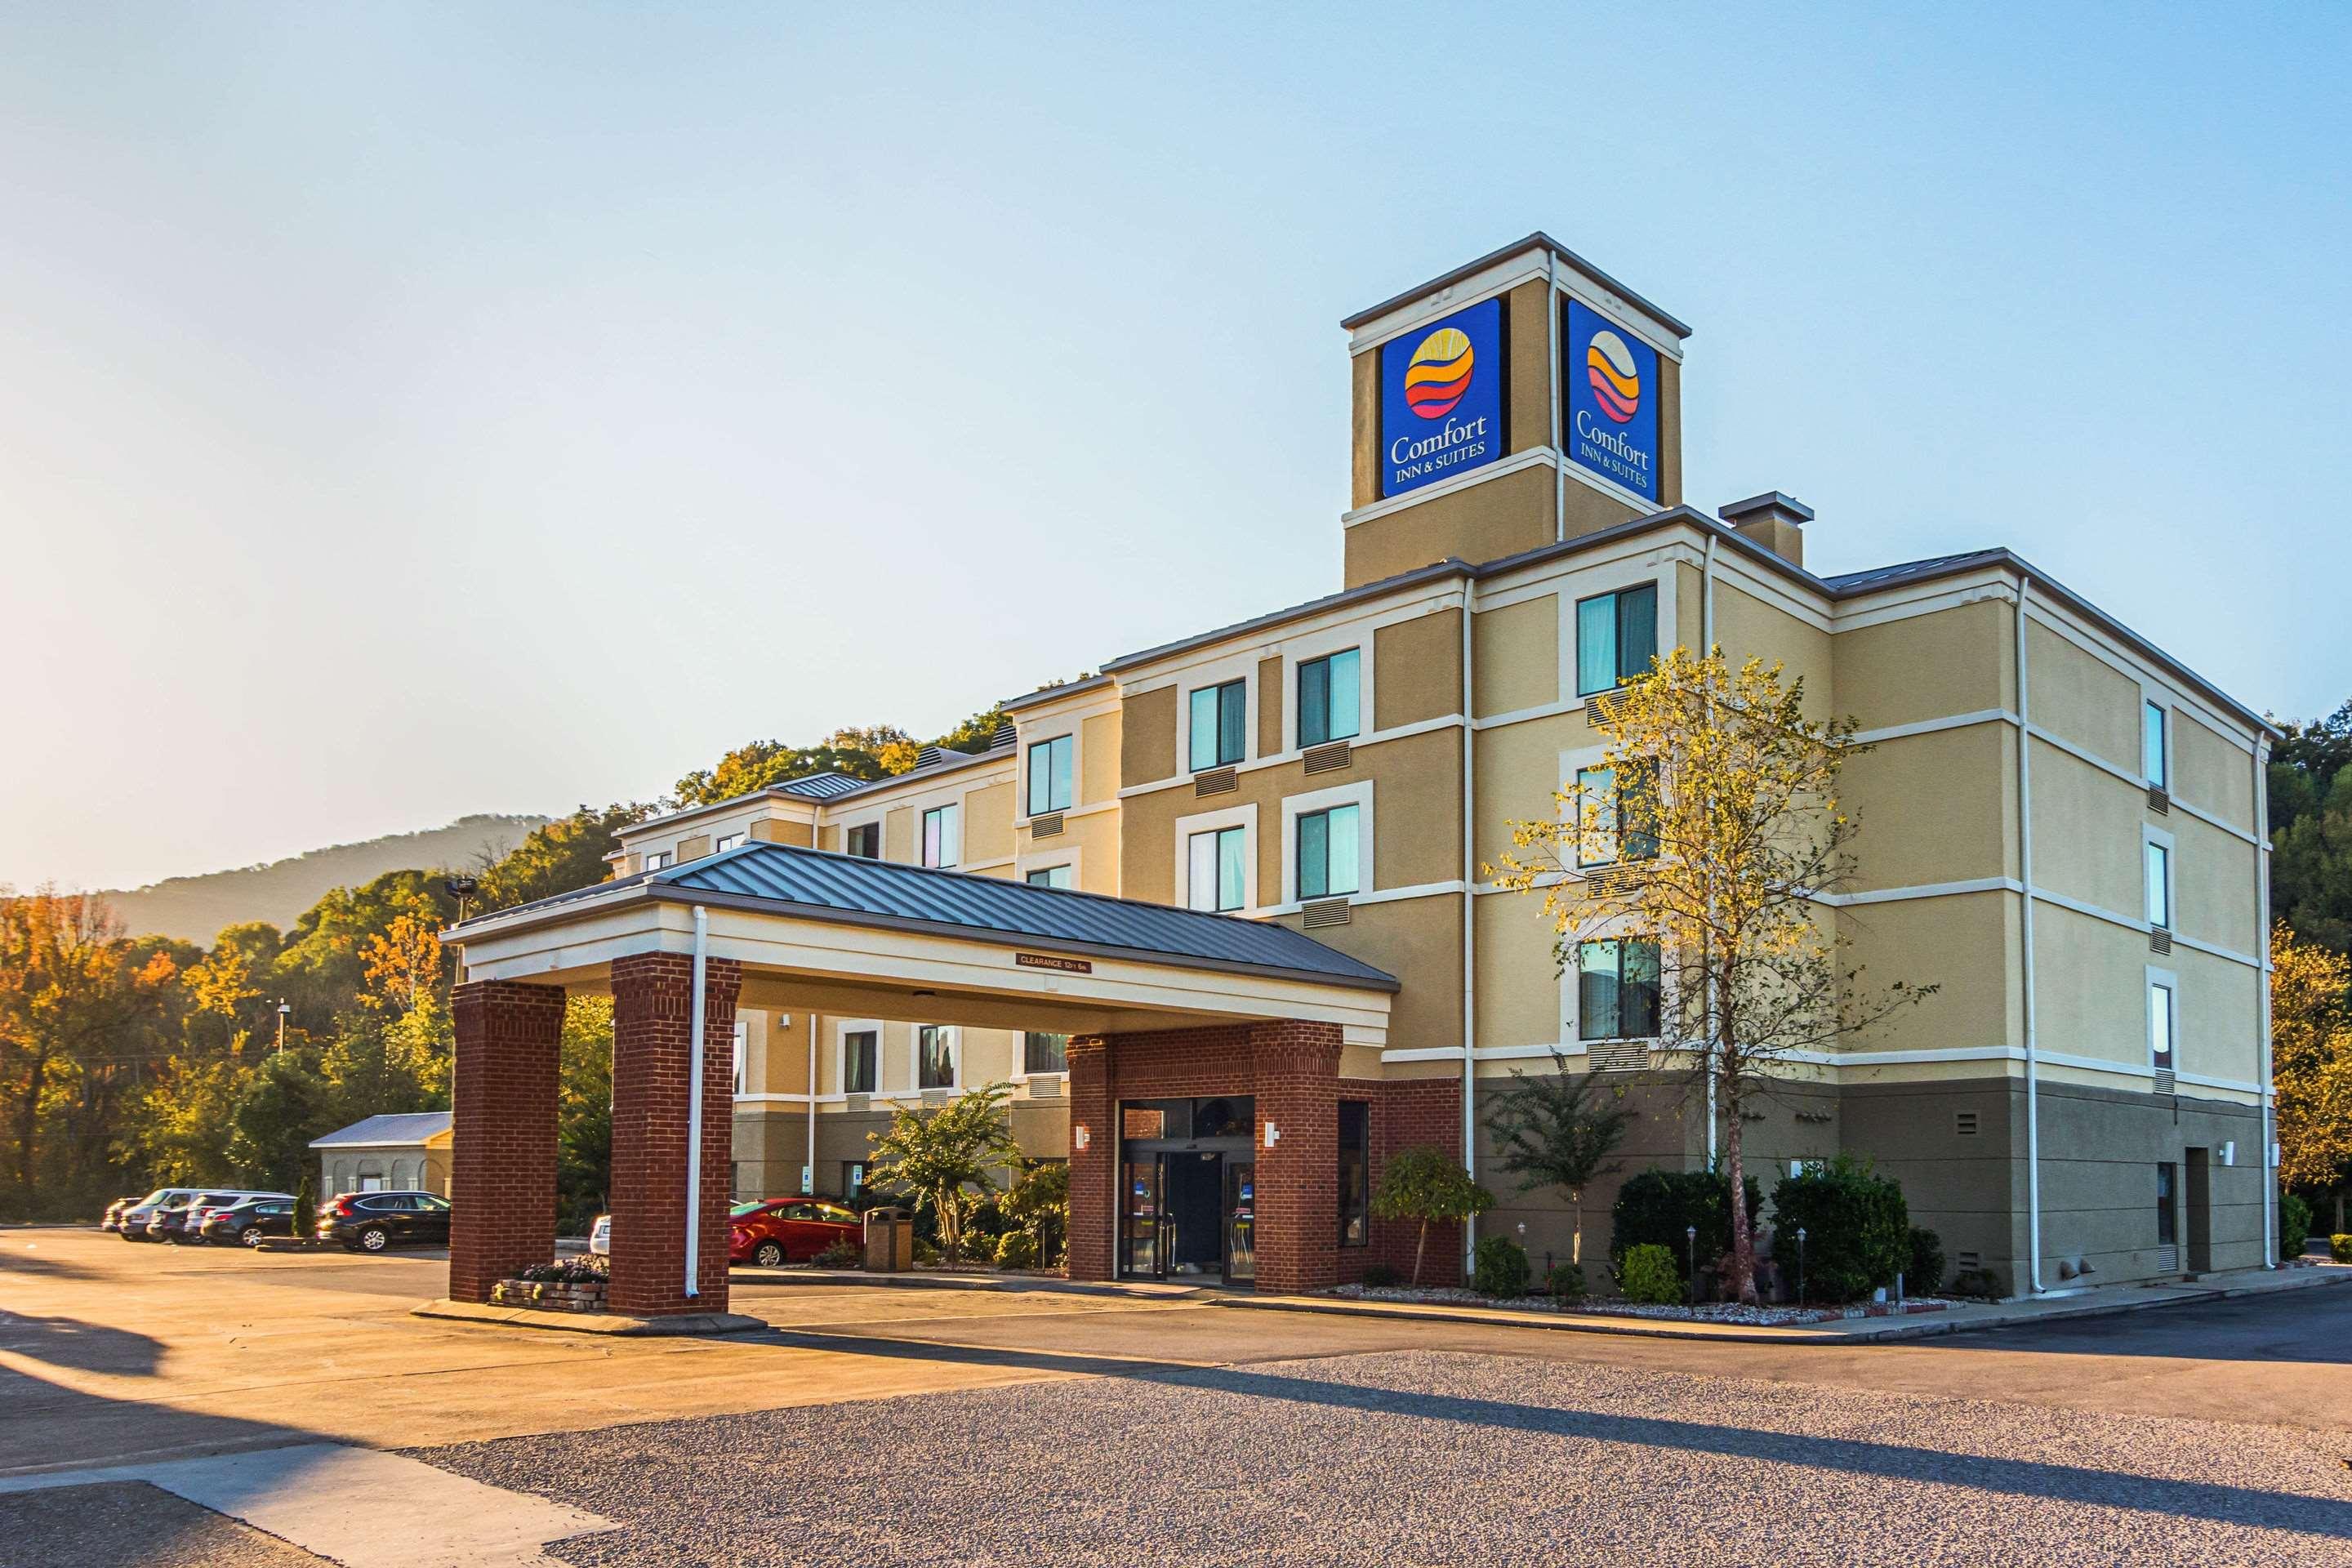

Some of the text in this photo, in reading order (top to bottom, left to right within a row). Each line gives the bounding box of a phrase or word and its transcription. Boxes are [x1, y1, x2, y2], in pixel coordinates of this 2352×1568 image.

[1391, 416, 1486, 464] Comfort
[1396, 441, 1485, 483] INN & SUITES
[1577, 410, 1649, 470] Comfort
[1581, 442, 1647, 488] INN & SUITES
[1020, 956, 1062, 968] CLEARANCE
